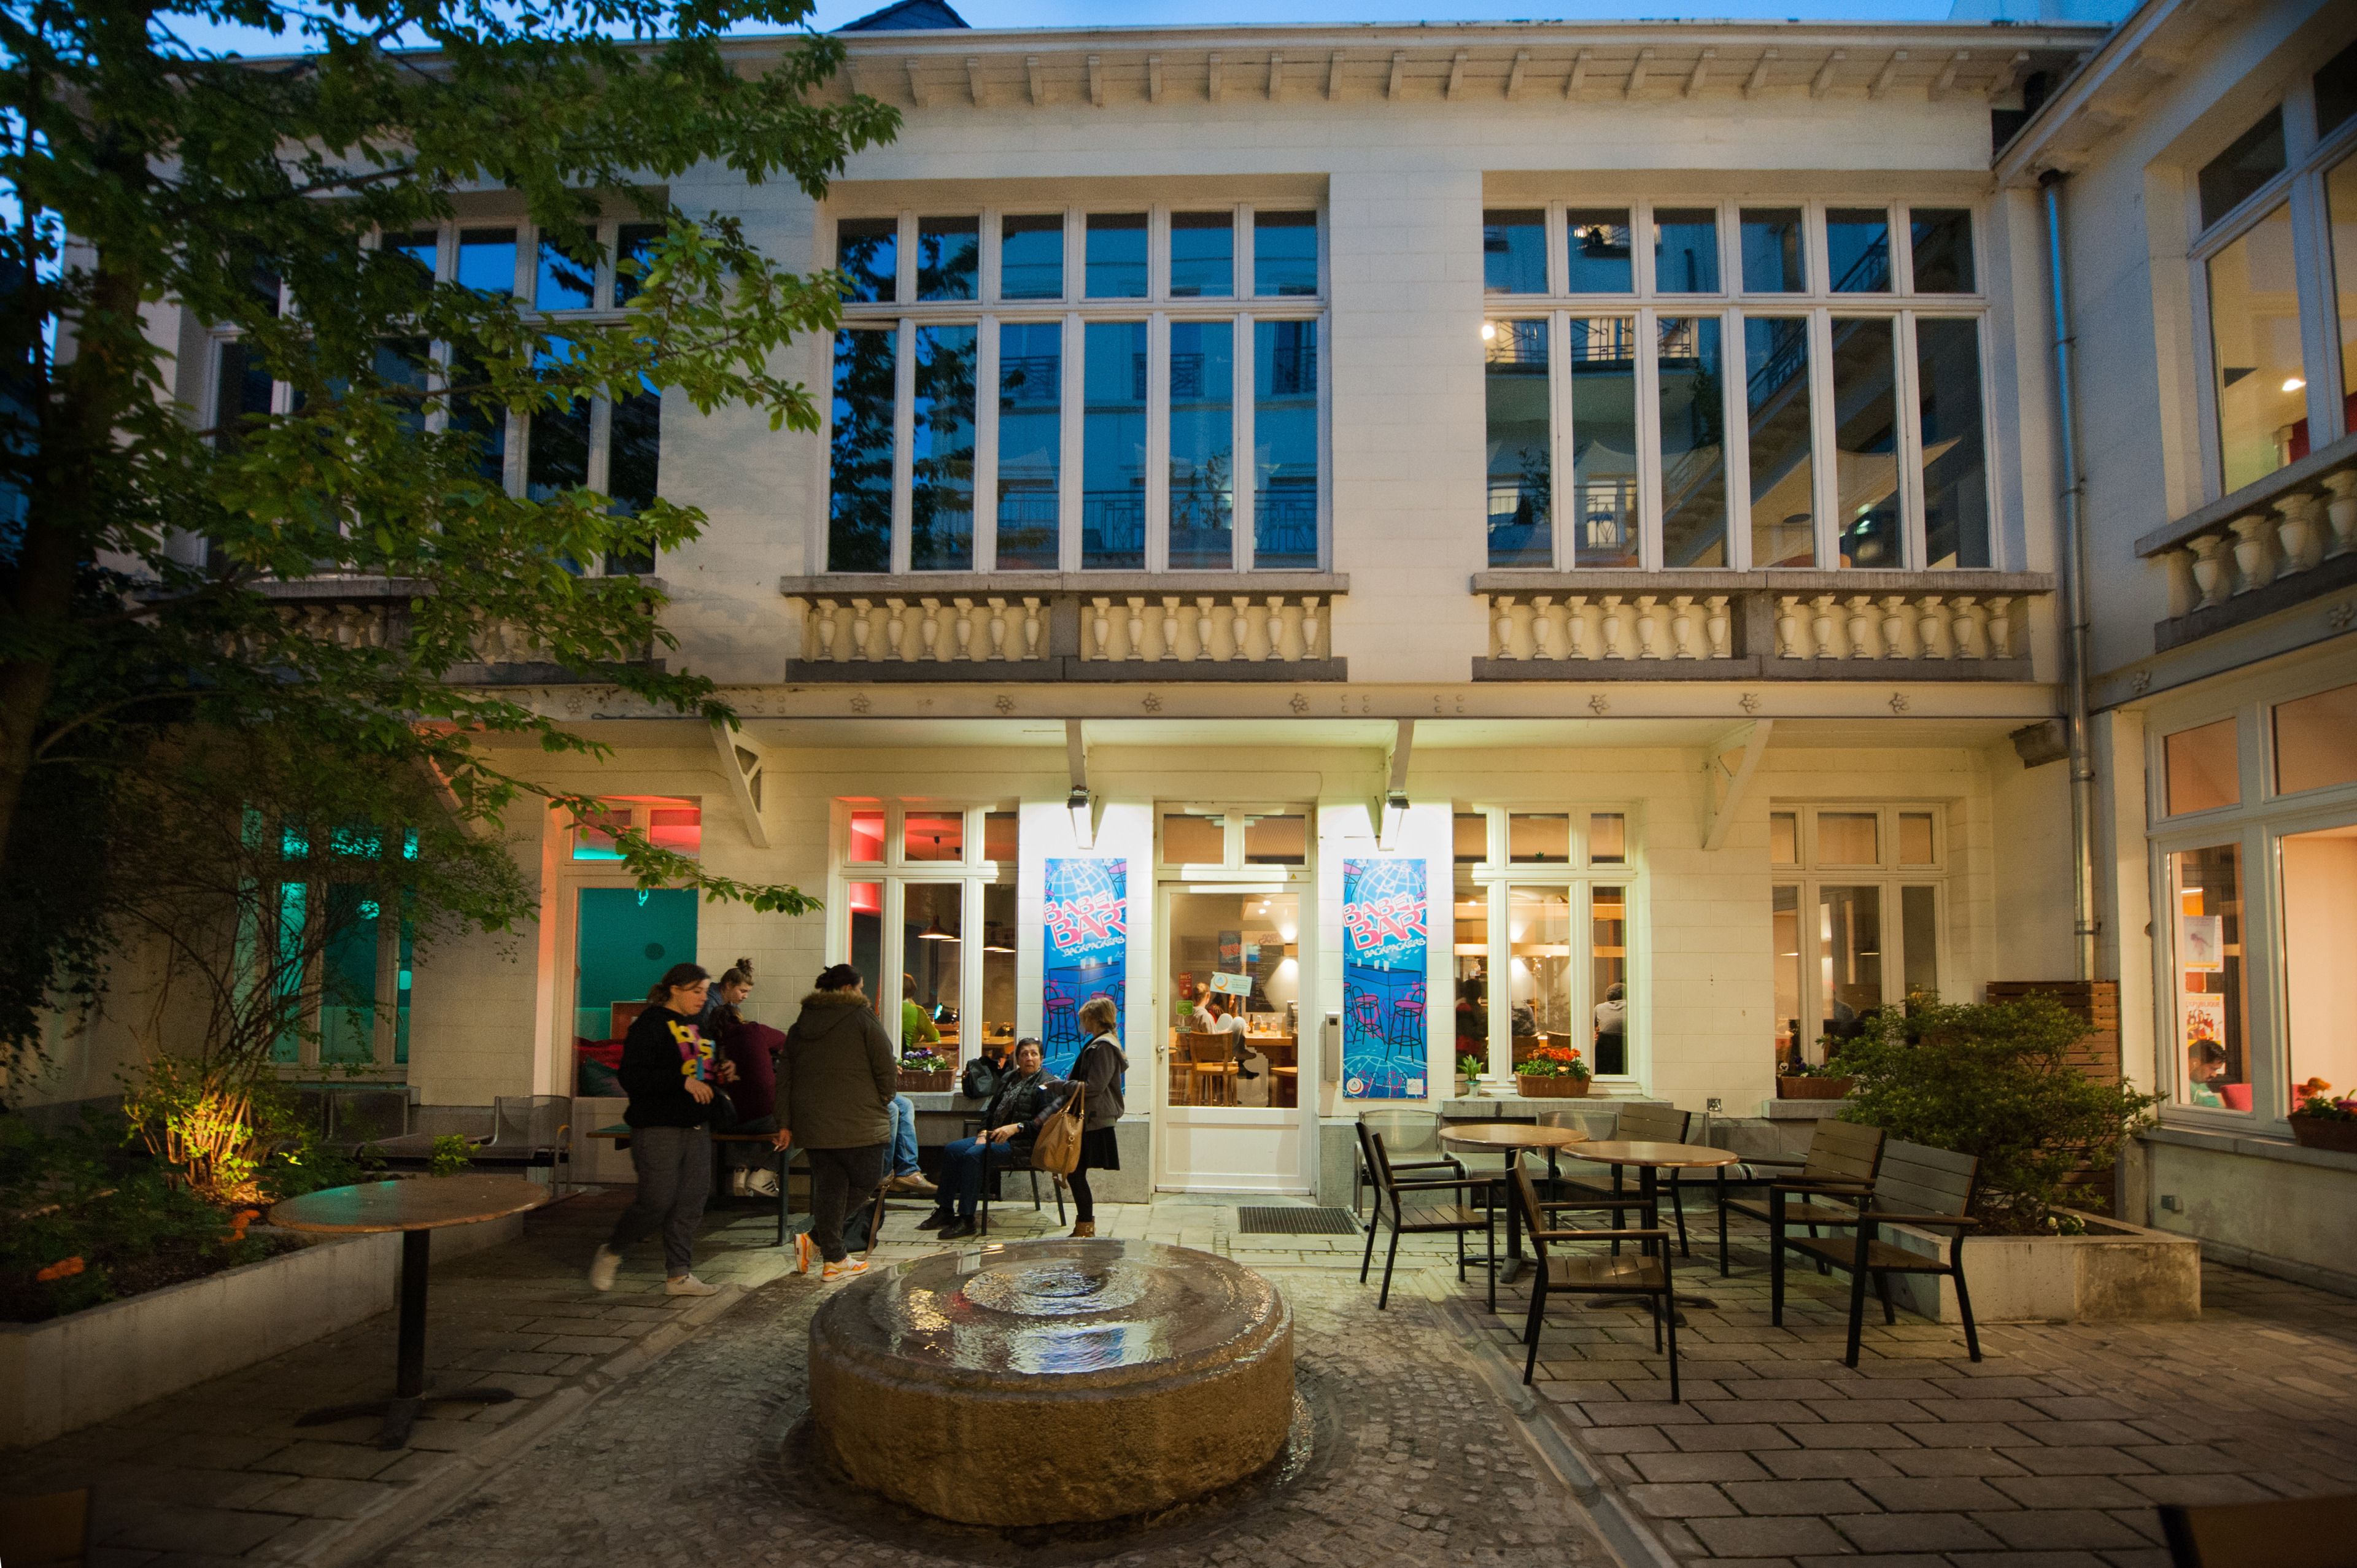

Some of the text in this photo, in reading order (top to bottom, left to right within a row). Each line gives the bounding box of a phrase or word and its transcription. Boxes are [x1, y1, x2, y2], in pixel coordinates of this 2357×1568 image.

[1043, 890, 1127, 925] BABEL
[1342, 891, 1427, 927] BABEL
[1051, 908, 1127, 949] BAR
[1062, 935, 1125, 957] BACKPACKERS
[1351, 910, 1427, 951] BAR
[1363, 937, 1426, 959] BACKPACKERS
